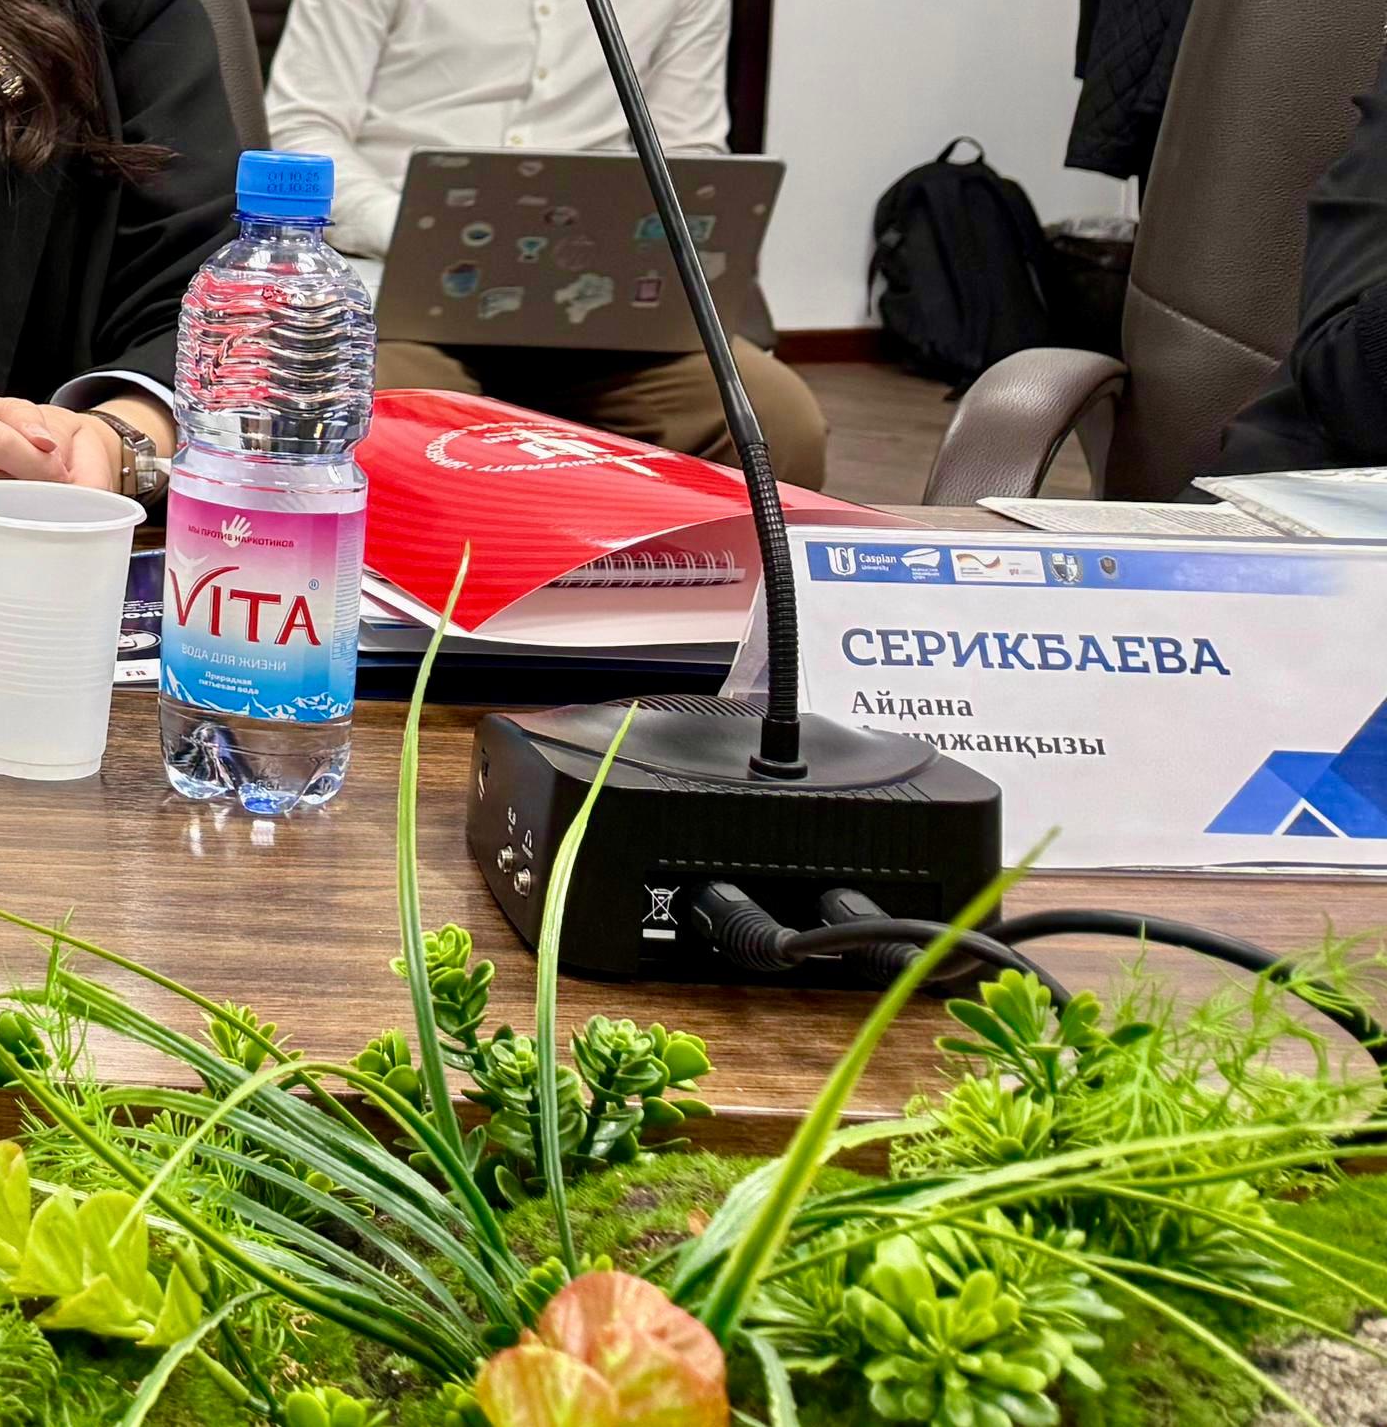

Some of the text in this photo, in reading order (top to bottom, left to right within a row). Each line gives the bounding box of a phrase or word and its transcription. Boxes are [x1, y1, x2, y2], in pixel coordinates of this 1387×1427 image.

[201, 528, 233, 541] ПРОТИВ
[234, 534, 295, 548] НАРКОТИКОВ
[859, 553, 897, 565] Caspian
[168, 566, 322, 646] VITA
[181, 643, 287, 671] ВОДА ДЛЯ ЖИЗНИ
[841, 627, 1232, 676] СЕРИКБАЕВА
[204, 670, 253, 686] Природная
[237, 686, 260, 695] вода
[850, 690, 974, 721] Айдана
[853, 725, 1107, 759] мжанқызы
